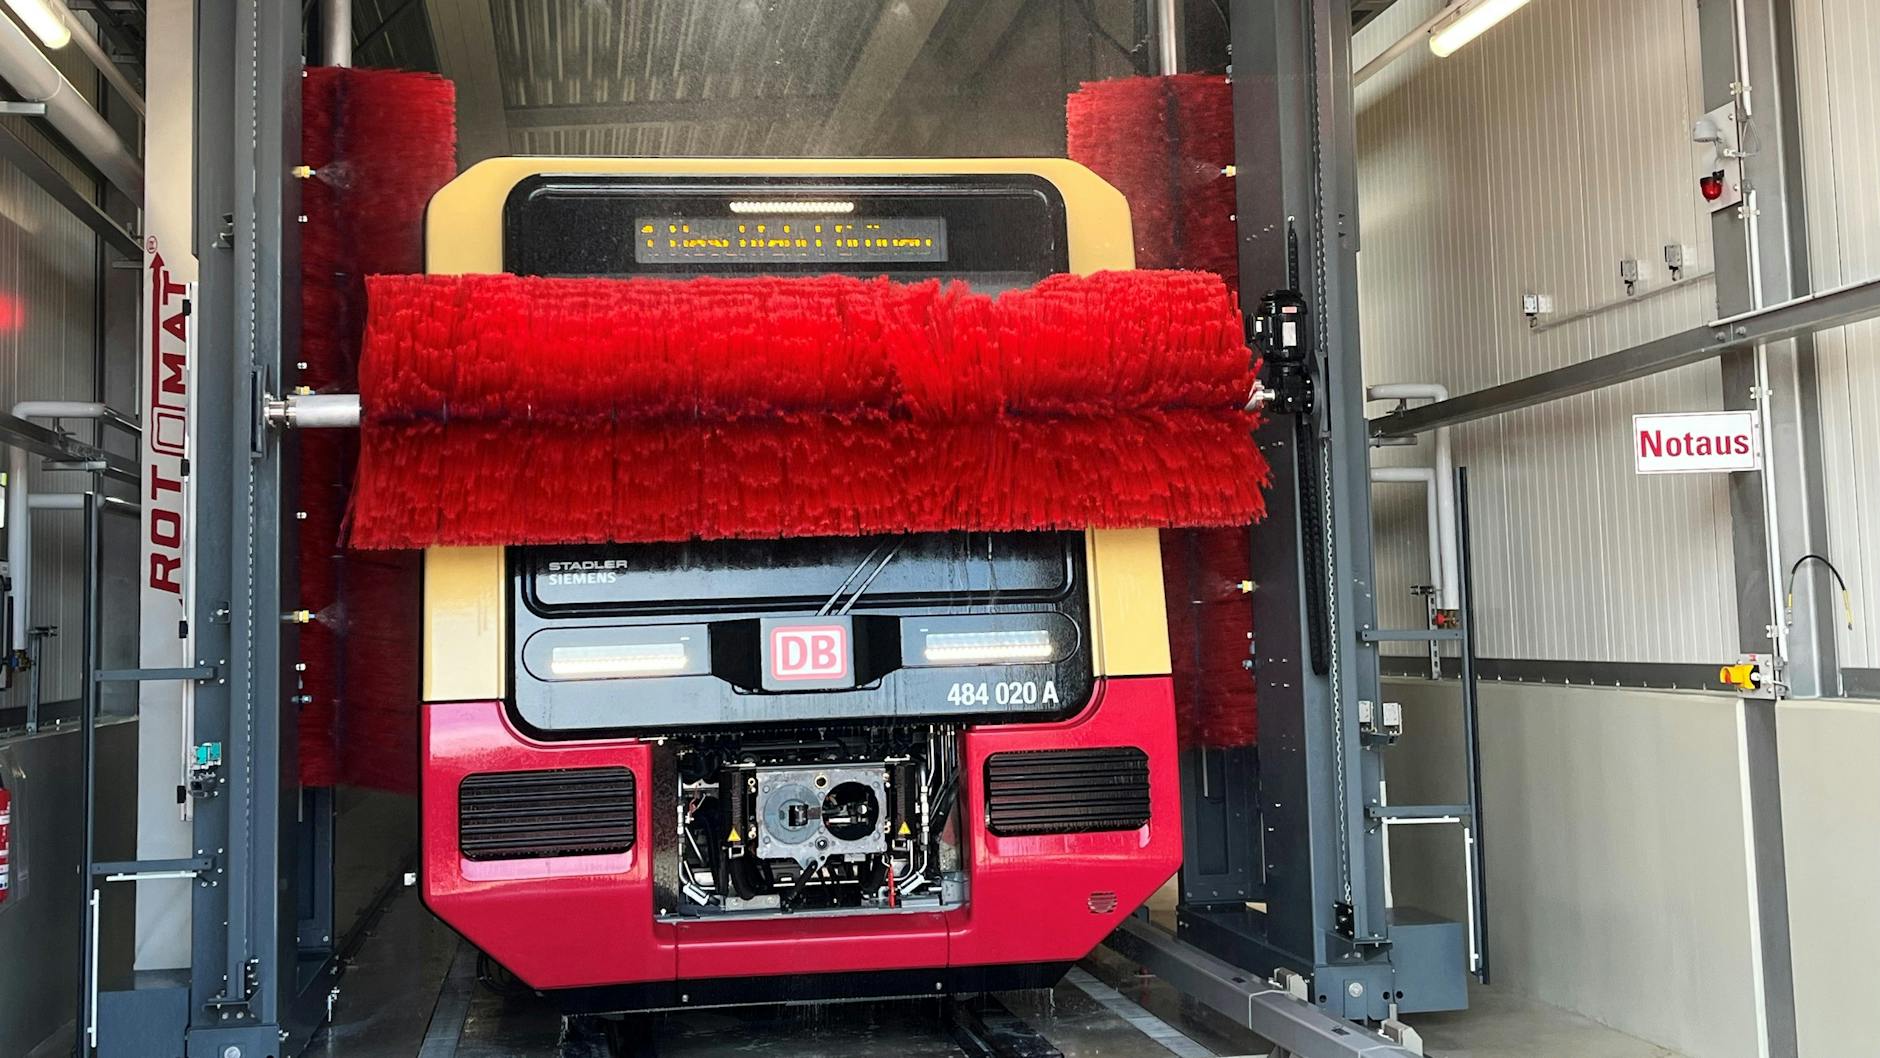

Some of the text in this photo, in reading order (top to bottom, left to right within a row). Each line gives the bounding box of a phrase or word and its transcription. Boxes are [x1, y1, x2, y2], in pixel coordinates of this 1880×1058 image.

[149, 270, 188, 595] ROTOMAT
[1640, 429, 1750, 458] Notaus
[548, 559, 628, 571] STADLER
[548, 571, 617, 586] SIEMENS
[780, 634, 838, 672] DB
[946, 679, 1060, 706] 484 020 A
